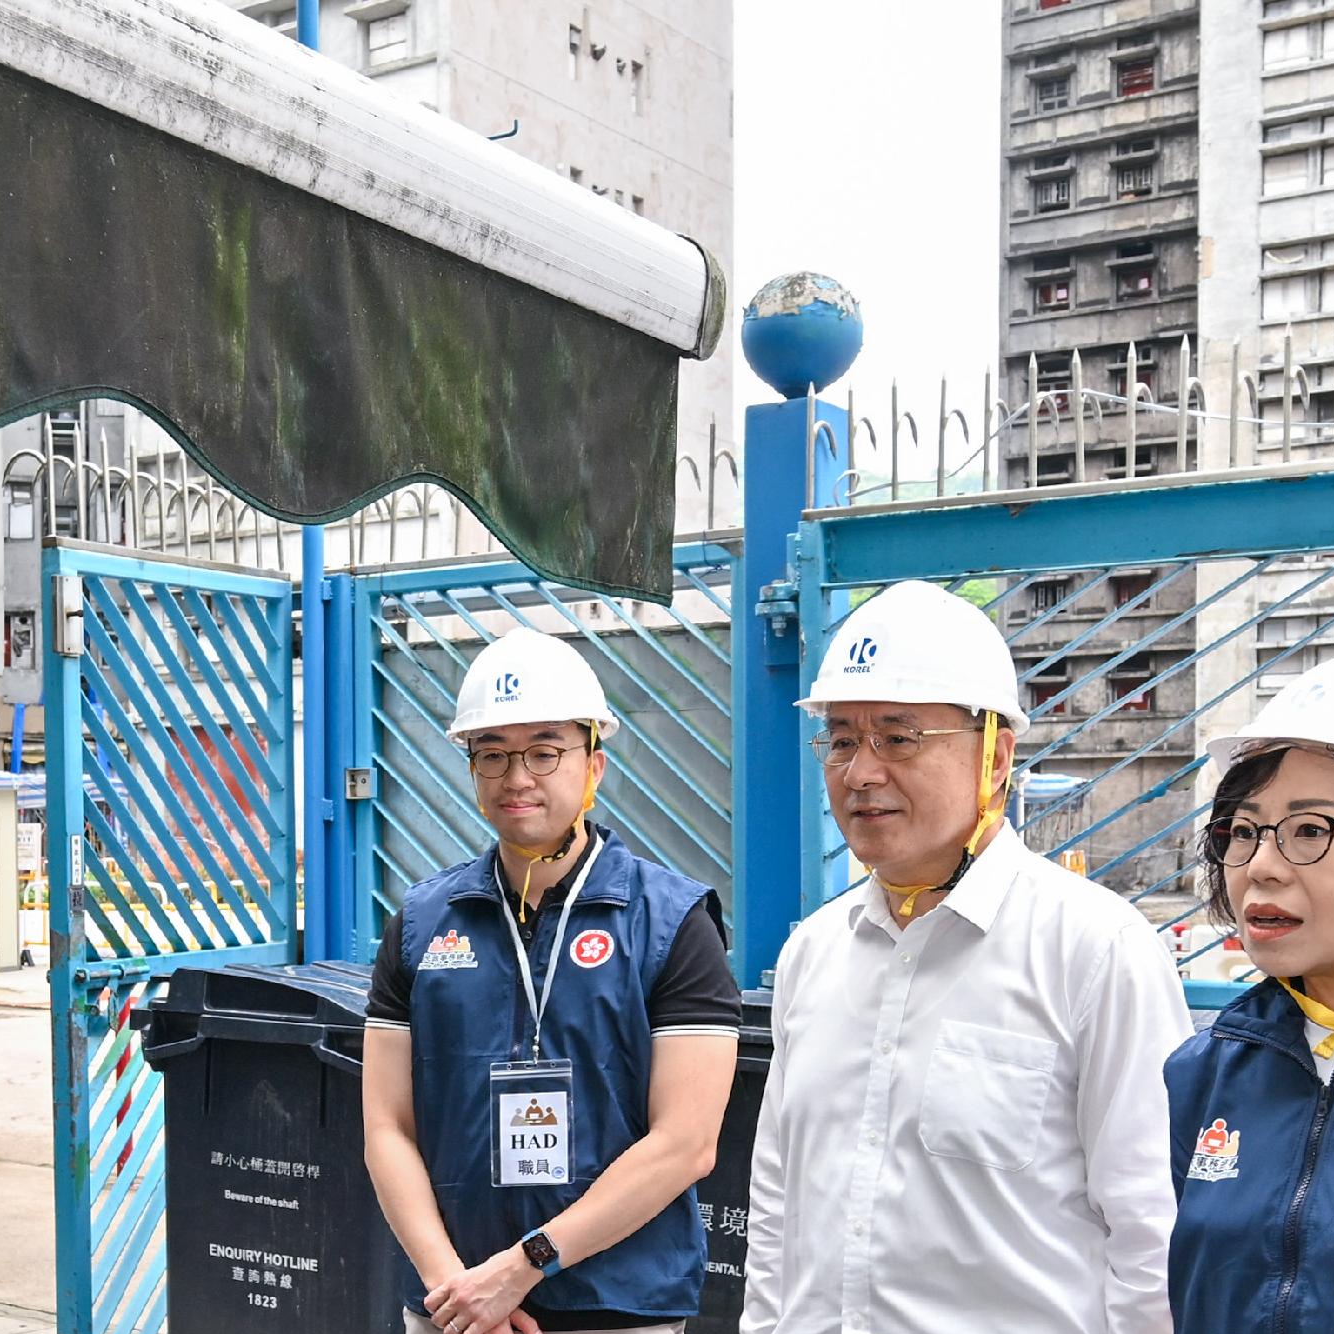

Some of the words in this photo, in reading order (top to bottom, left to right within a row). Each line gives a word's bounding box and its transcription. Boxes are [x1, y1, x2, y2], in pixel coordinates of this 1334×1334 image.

[843, 665, 870, 673] KOREL
[511, 1133, 558, 1149] HAD
[518, 1159, 550, 1176] 職員
[224, 1189, 254, 1203] Beware
[254, 1195, 264, 1204] of
[263, 1196, 277, 1207] the
[277, 1199, 300, 1210] shaft
[209, 1243, 262, 1263] ENQUIRY
[263, 1252, 318, 1272] HOTLINE
[231, 1266, 293, 1289] 查詢熱線
[247, 1292, 278, 1309] 1823
